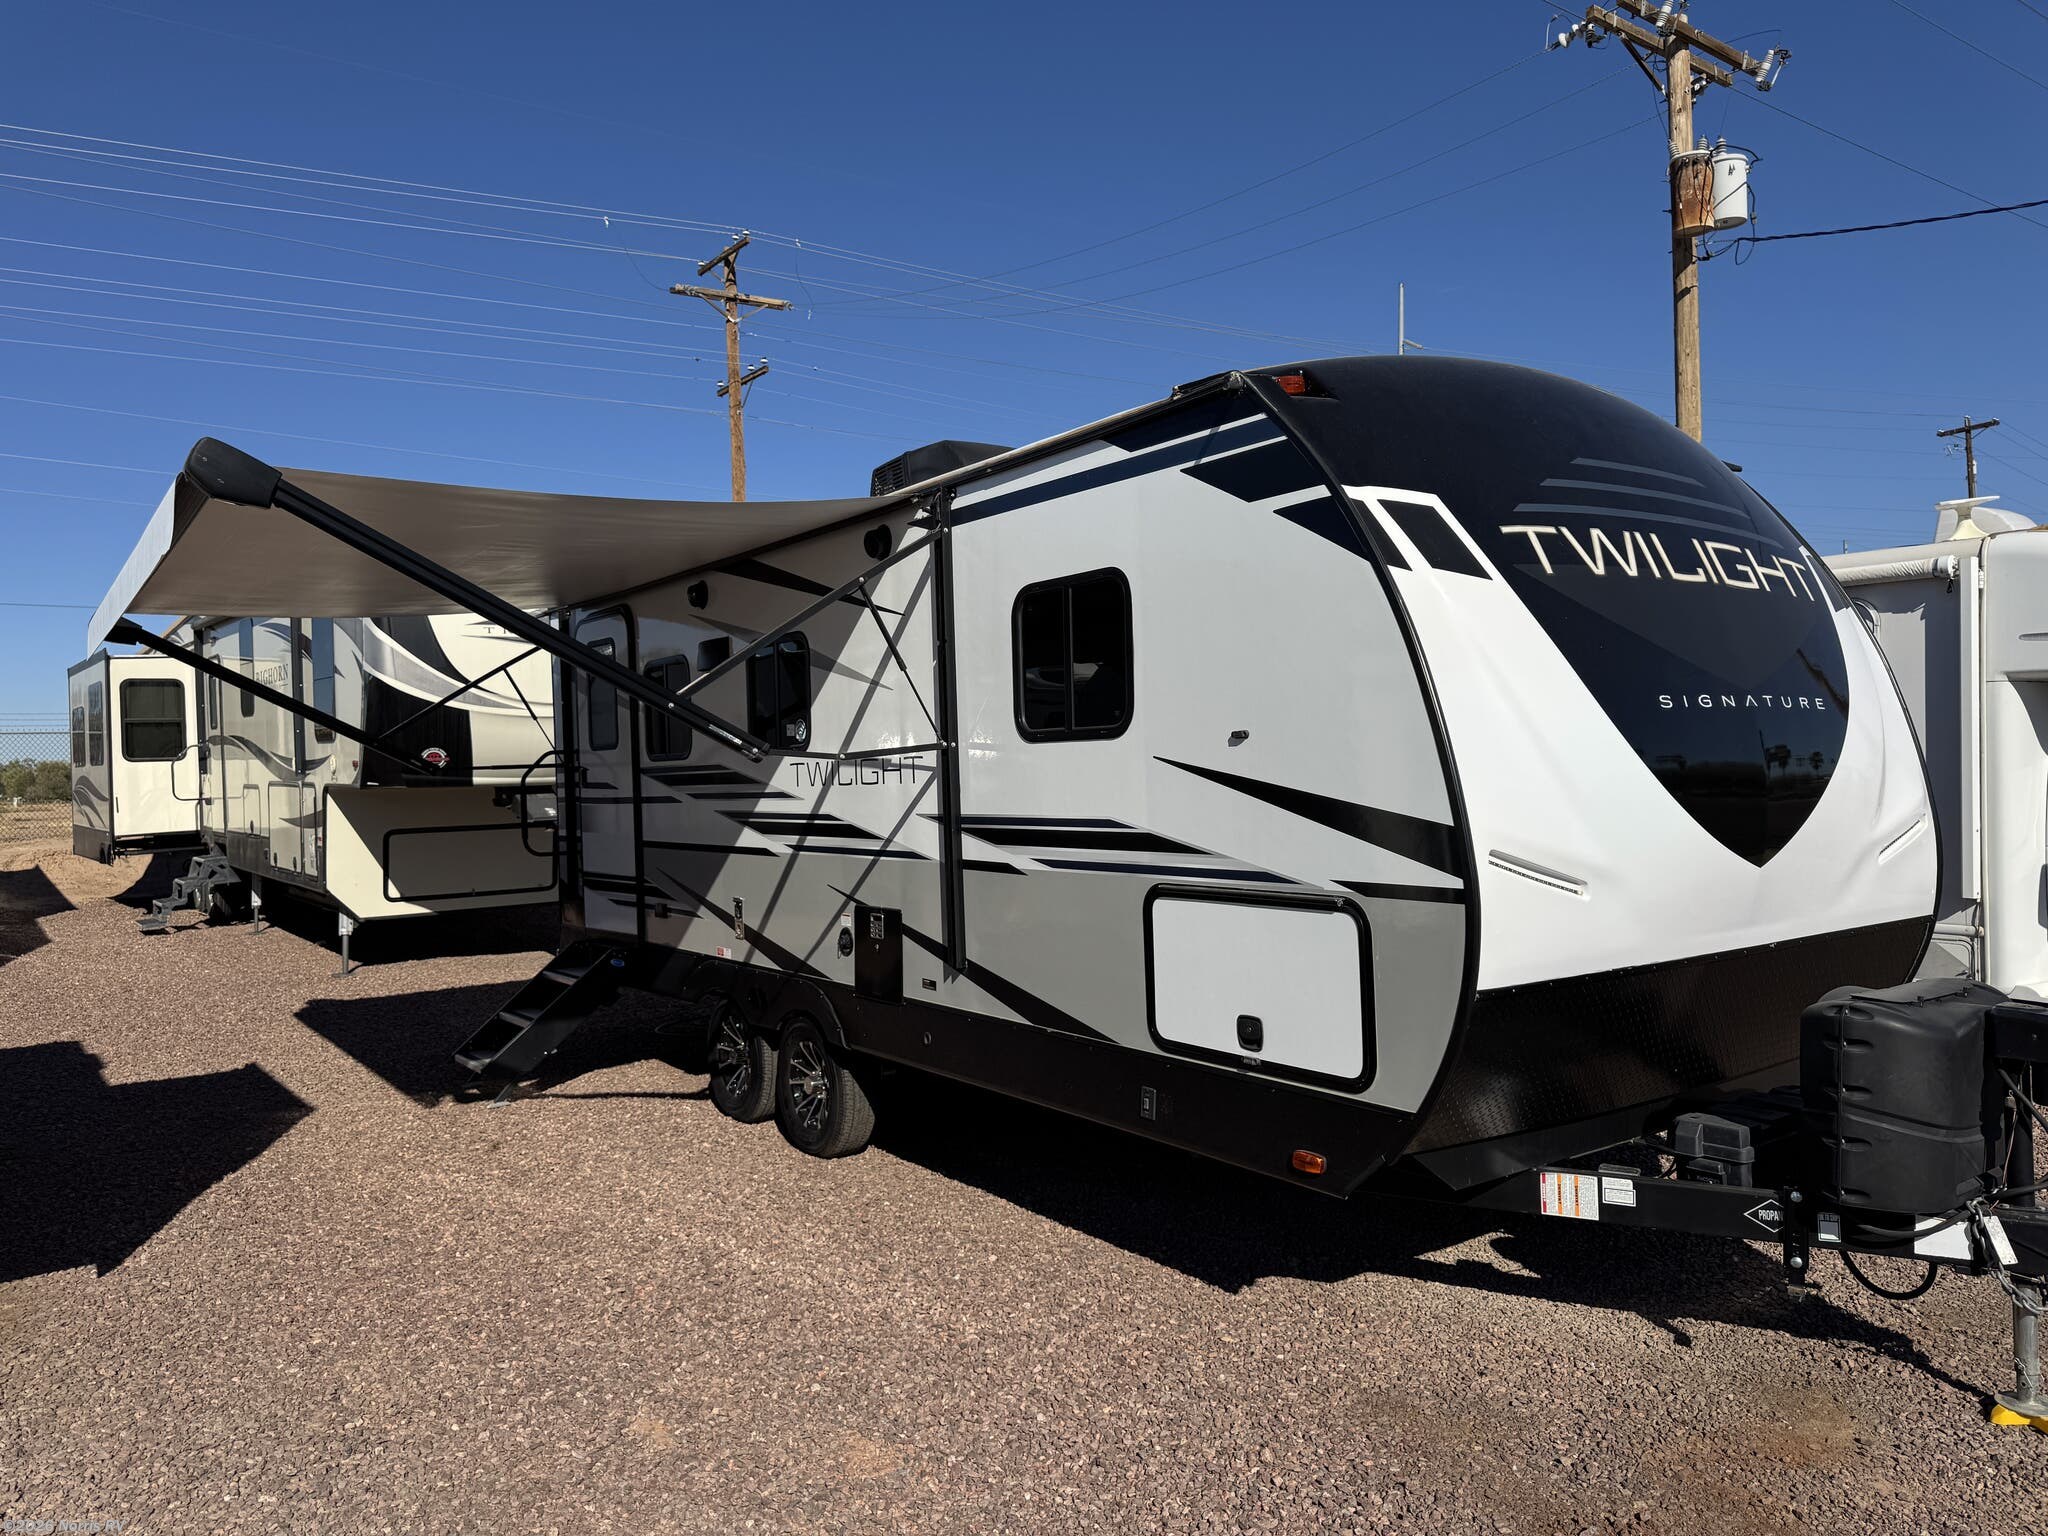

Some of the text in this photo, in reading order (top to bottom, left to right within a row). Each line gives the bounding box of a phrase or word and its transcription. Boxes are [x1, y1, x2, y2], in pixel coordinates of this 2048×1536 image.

[1499, 525, 1815, 602] TWILIGHT
[1658, 694, 1827, 711] SIGNATURE
[789, 756, 923, 787] TWILIGHT
[1758, 1209, 1784, 1221] PROPAN
